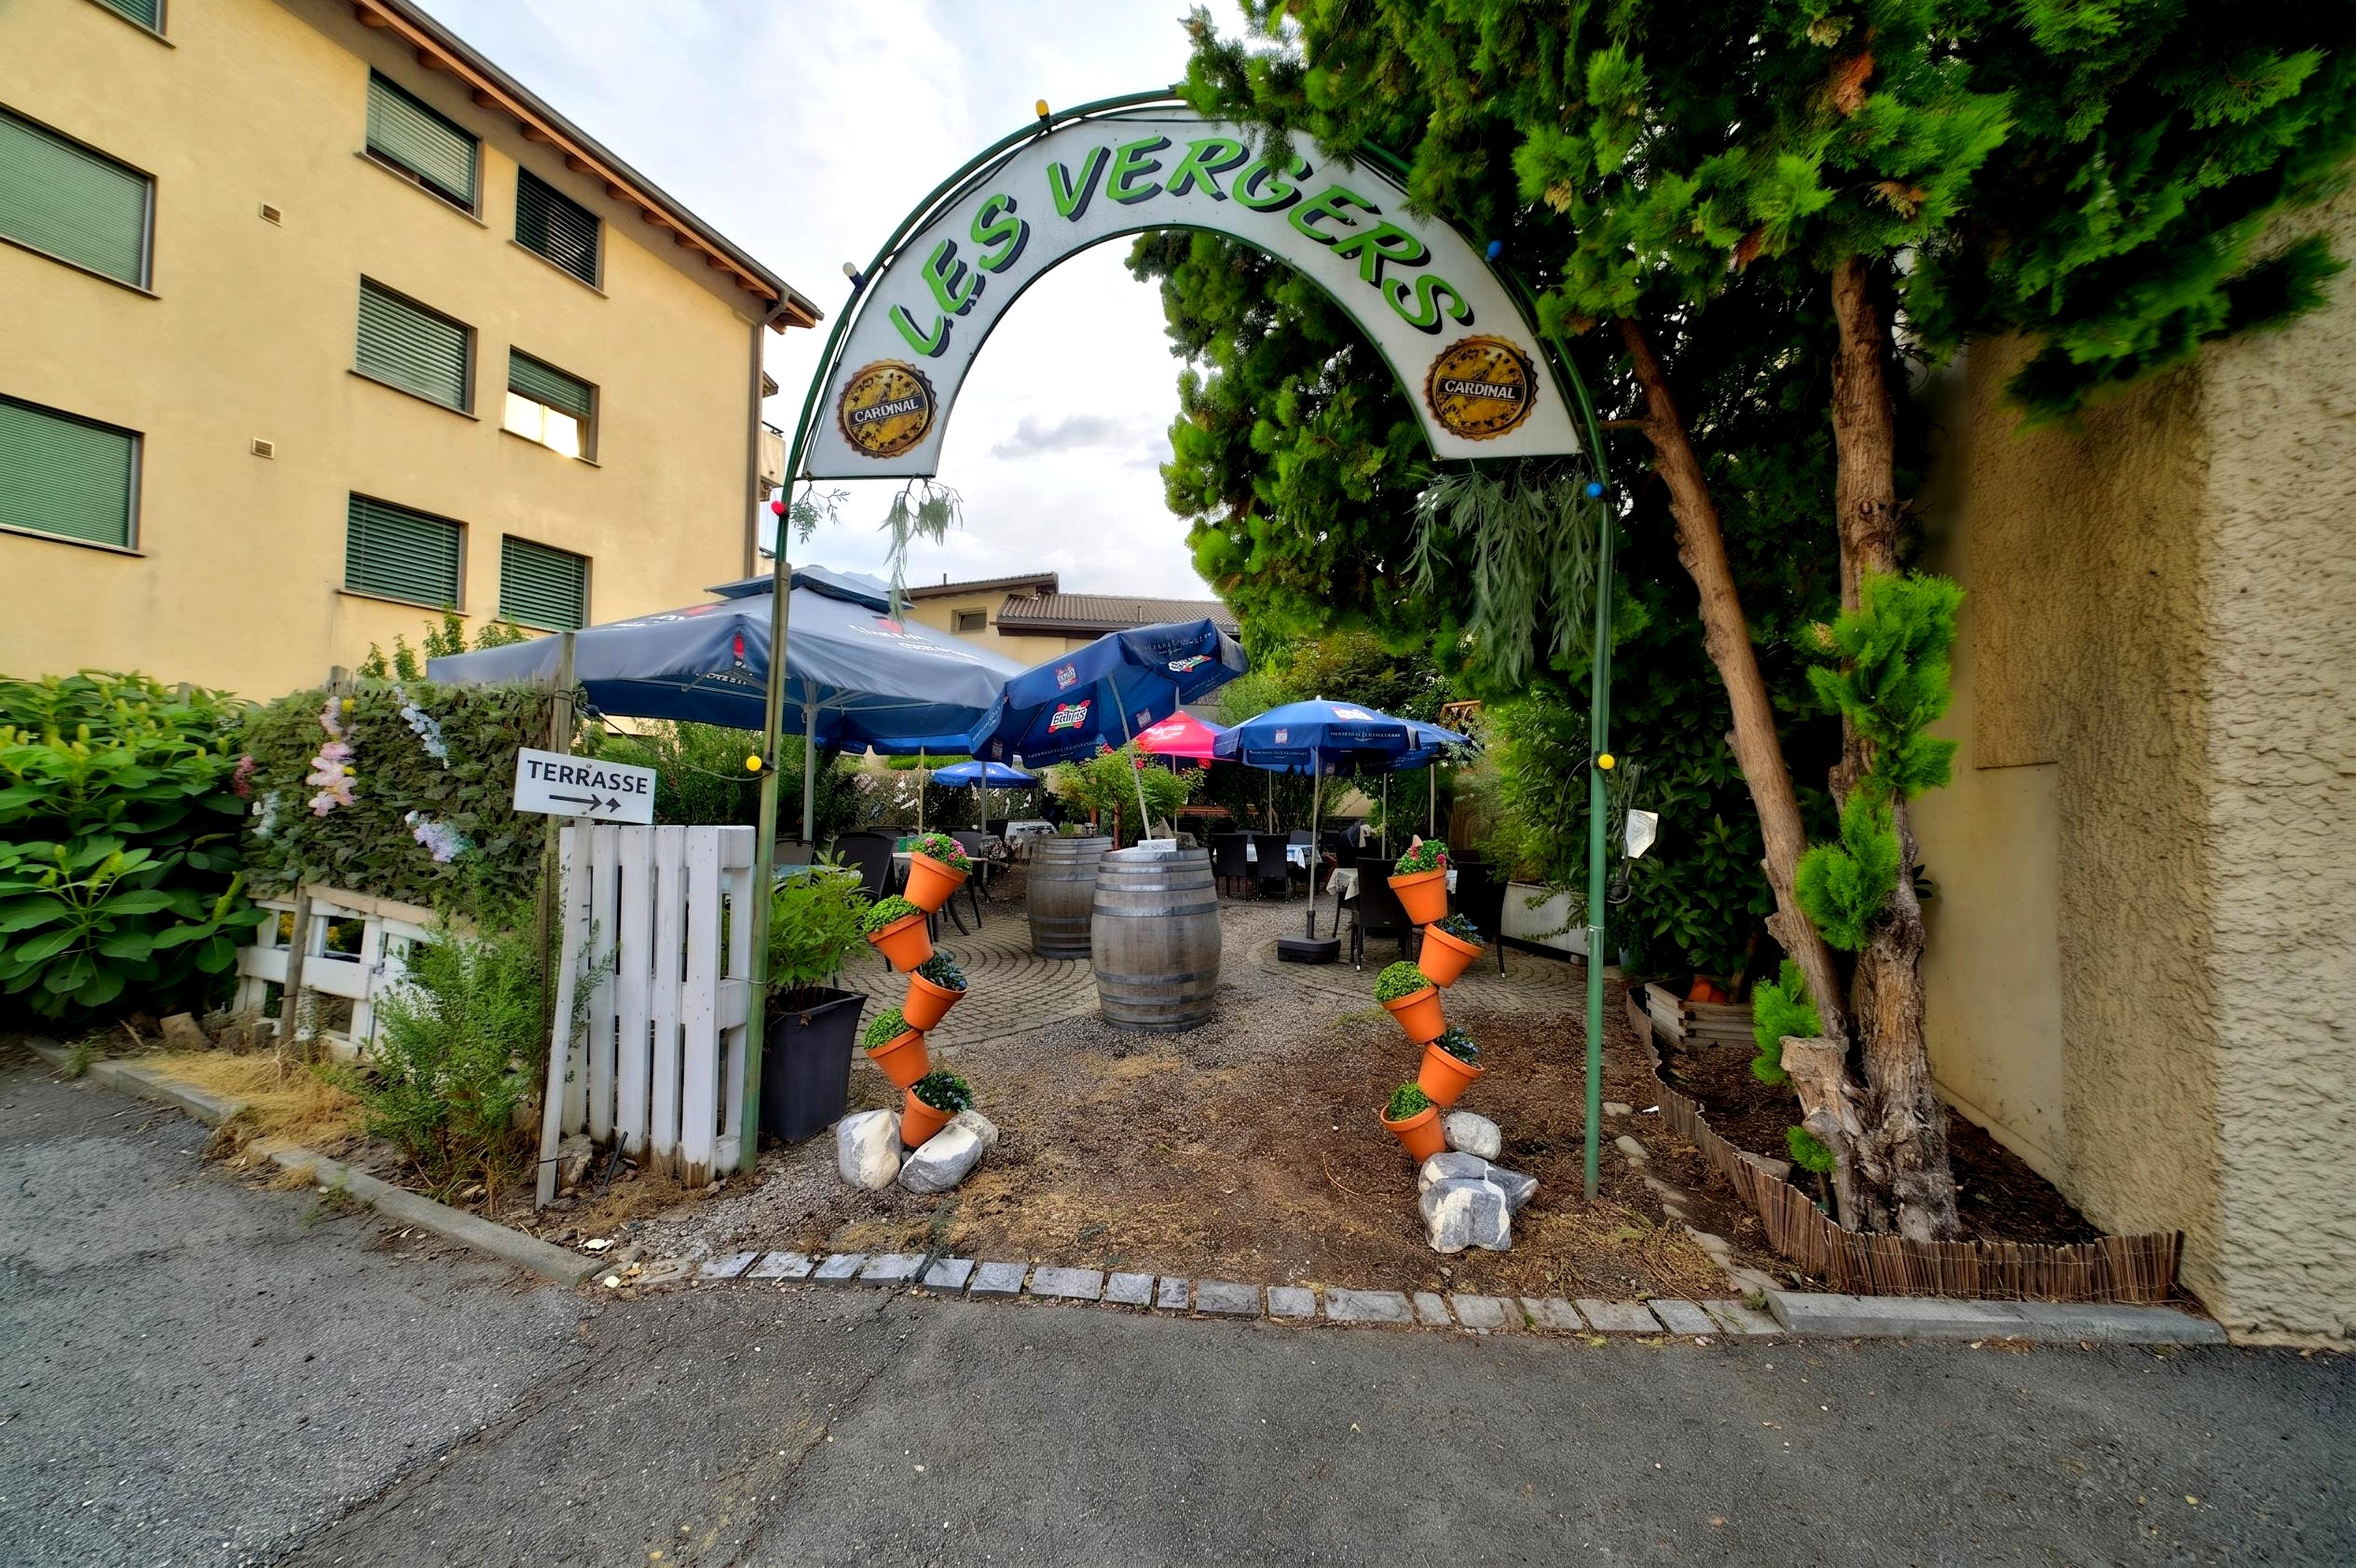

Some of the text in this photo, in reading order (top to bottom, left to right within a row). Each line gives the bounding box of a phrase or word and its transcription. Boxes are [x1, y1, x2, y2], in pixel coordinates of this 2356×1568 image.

[889, 136, 1475, 358] LES VERGERS
[1445, 380, 1515, 399] CARDINAL
[855, 399, 919, 423] CARDINAL
[527, 759, 649, 794] TERRASSE
